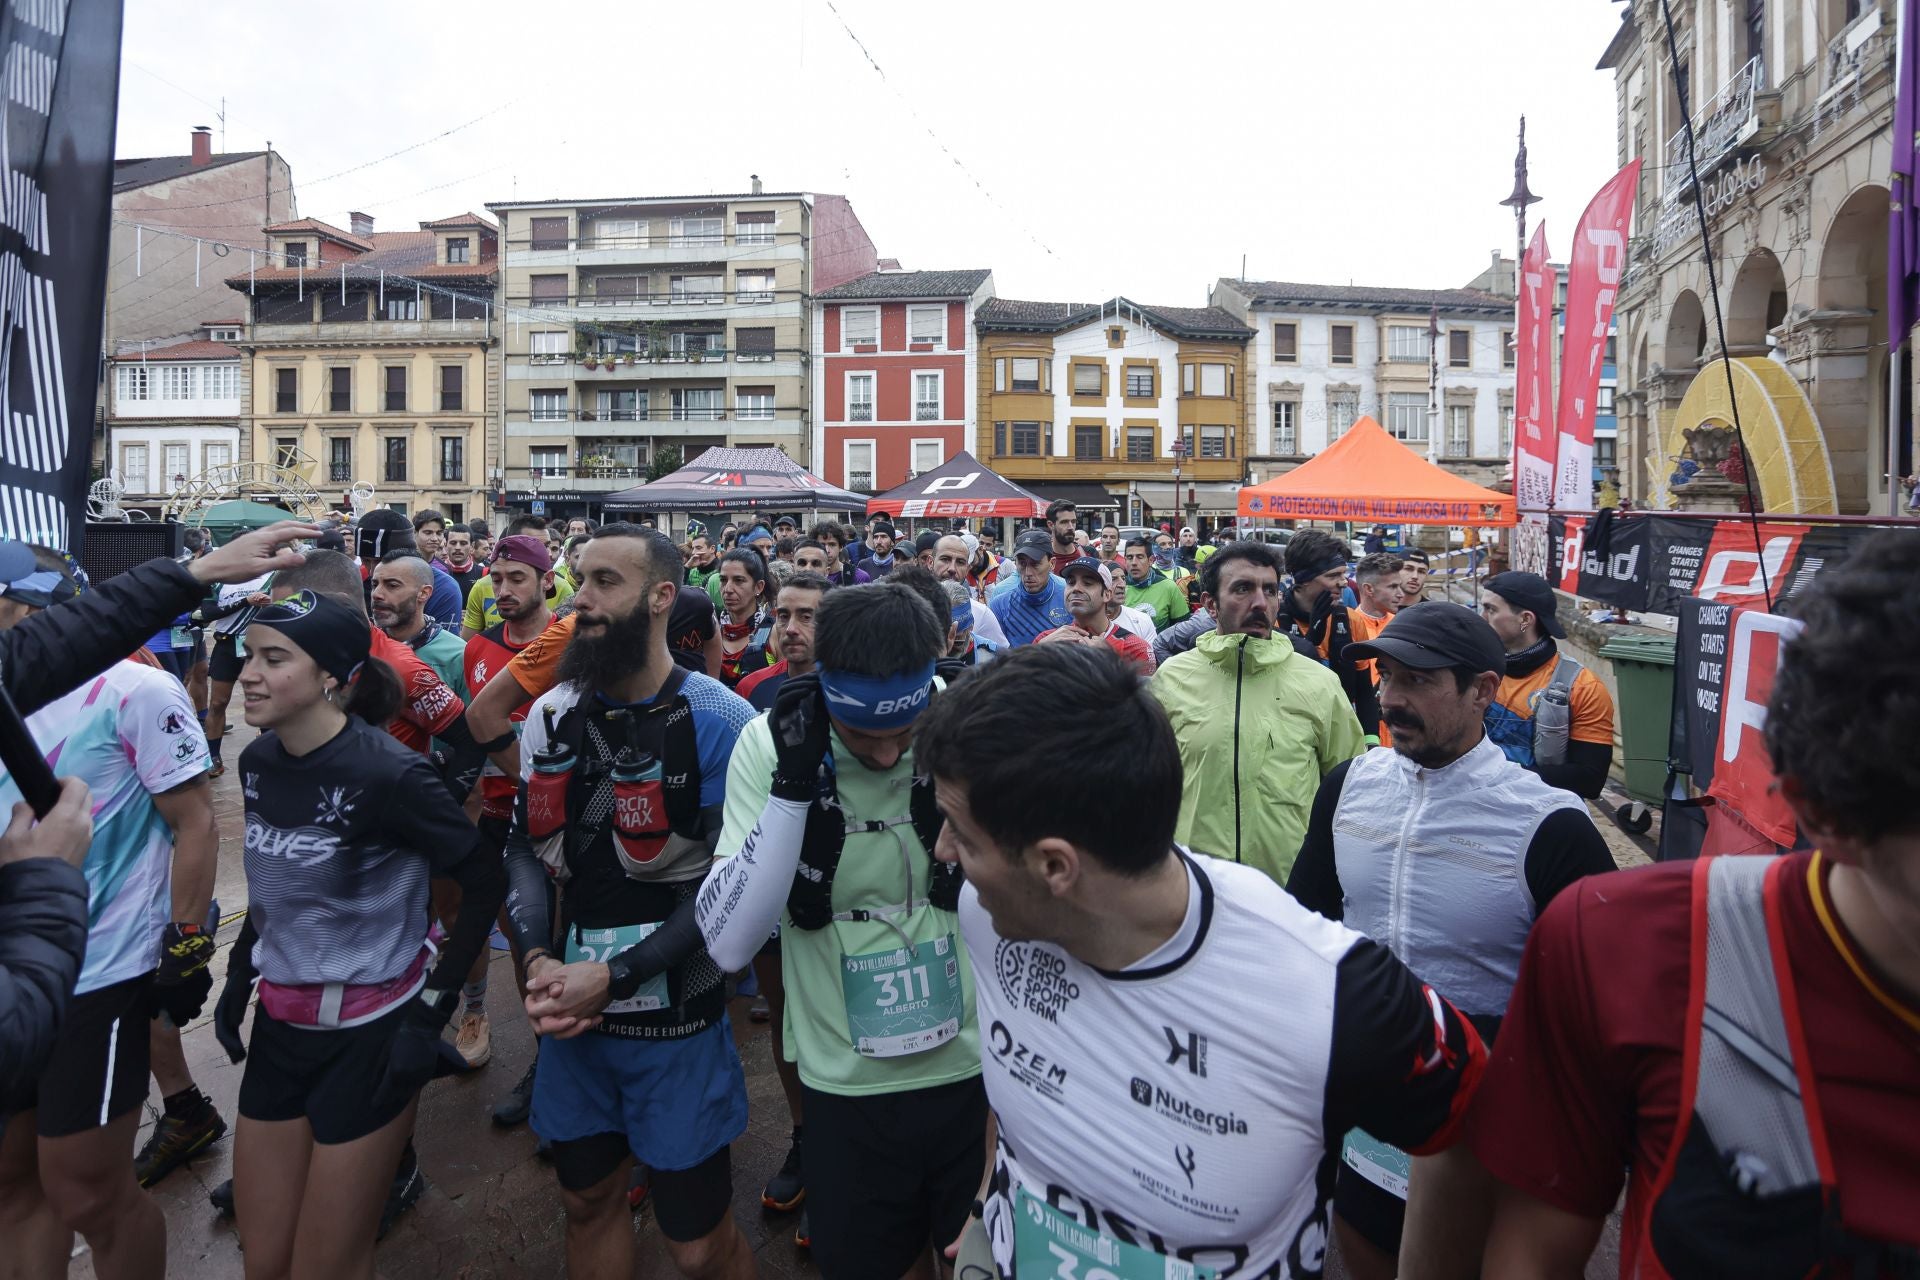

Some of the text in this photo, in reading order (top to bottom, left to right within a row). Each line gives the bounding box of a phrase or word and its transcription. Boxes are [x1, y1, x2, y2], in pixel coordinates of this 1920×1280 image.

[1341, 499, 1368, 517] CIVIL
[1372, 499, 1447, 520] VILLAVICIOSA
[1452, 503, 1470, 520] 112
[1668, 545, 1703, 557] CHANGES
[1670, 556, 1700, 567] STARTS
[1668, 579, 1693, 590] INSIDE
[1669, 567, 1697, 579] ON THE
[1698, 605, 1729, 626] CHANGES
[1700, 633, 1725, 655] STARTS
[1698, 660, 1722, 684] ON THE
[874, 680, 931, 715] BROO
[619, 807, 653, 828] MAX
[245, 823, 341, 867] OLVES
[722, 868, 749, 916] CARRERA
[1031, 947, 1066, 976] FISIO
[873, 964, 931, 1007] 311
[1028, 963, 1080, 1000] CASTRO
[1025, 977, 1070, 1013] SPORT
[883, 1000, 929, 1017] ALBERTO
[1023, 992, 1057, 1025] TEAM
[608, 1023, 643, 1036] PICOS
[644, 1026, 660, 1037] DE
[661, 1018, 707, 1037] EUROPA
[1155, 1086, 1248, 1135] Nutergia
[1131, 1167, 1179, 1200] MIQUEL
[1182, 1192, 1240, 1216] BONILLA
[1045, 1210, 1056, 1233] XI
